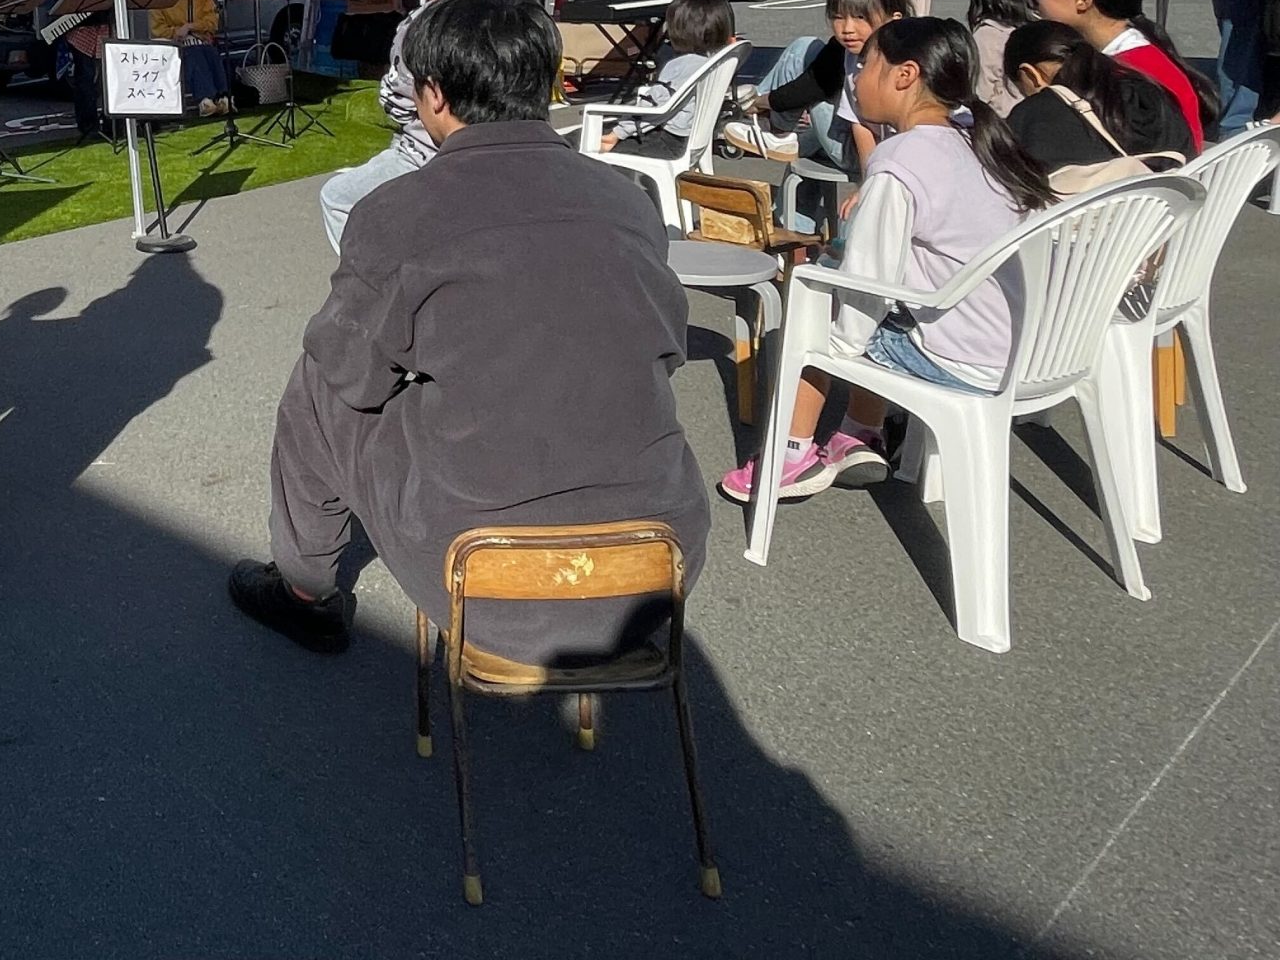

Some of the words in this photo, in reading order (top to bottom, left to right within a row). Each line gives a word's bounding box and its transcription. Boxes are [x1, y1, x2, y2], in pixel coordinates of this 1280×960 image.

[120, 52, 168, 66] ストリート
[131, 70, 160, 83] ライブ
[127, 87, 166, 100] スペース
